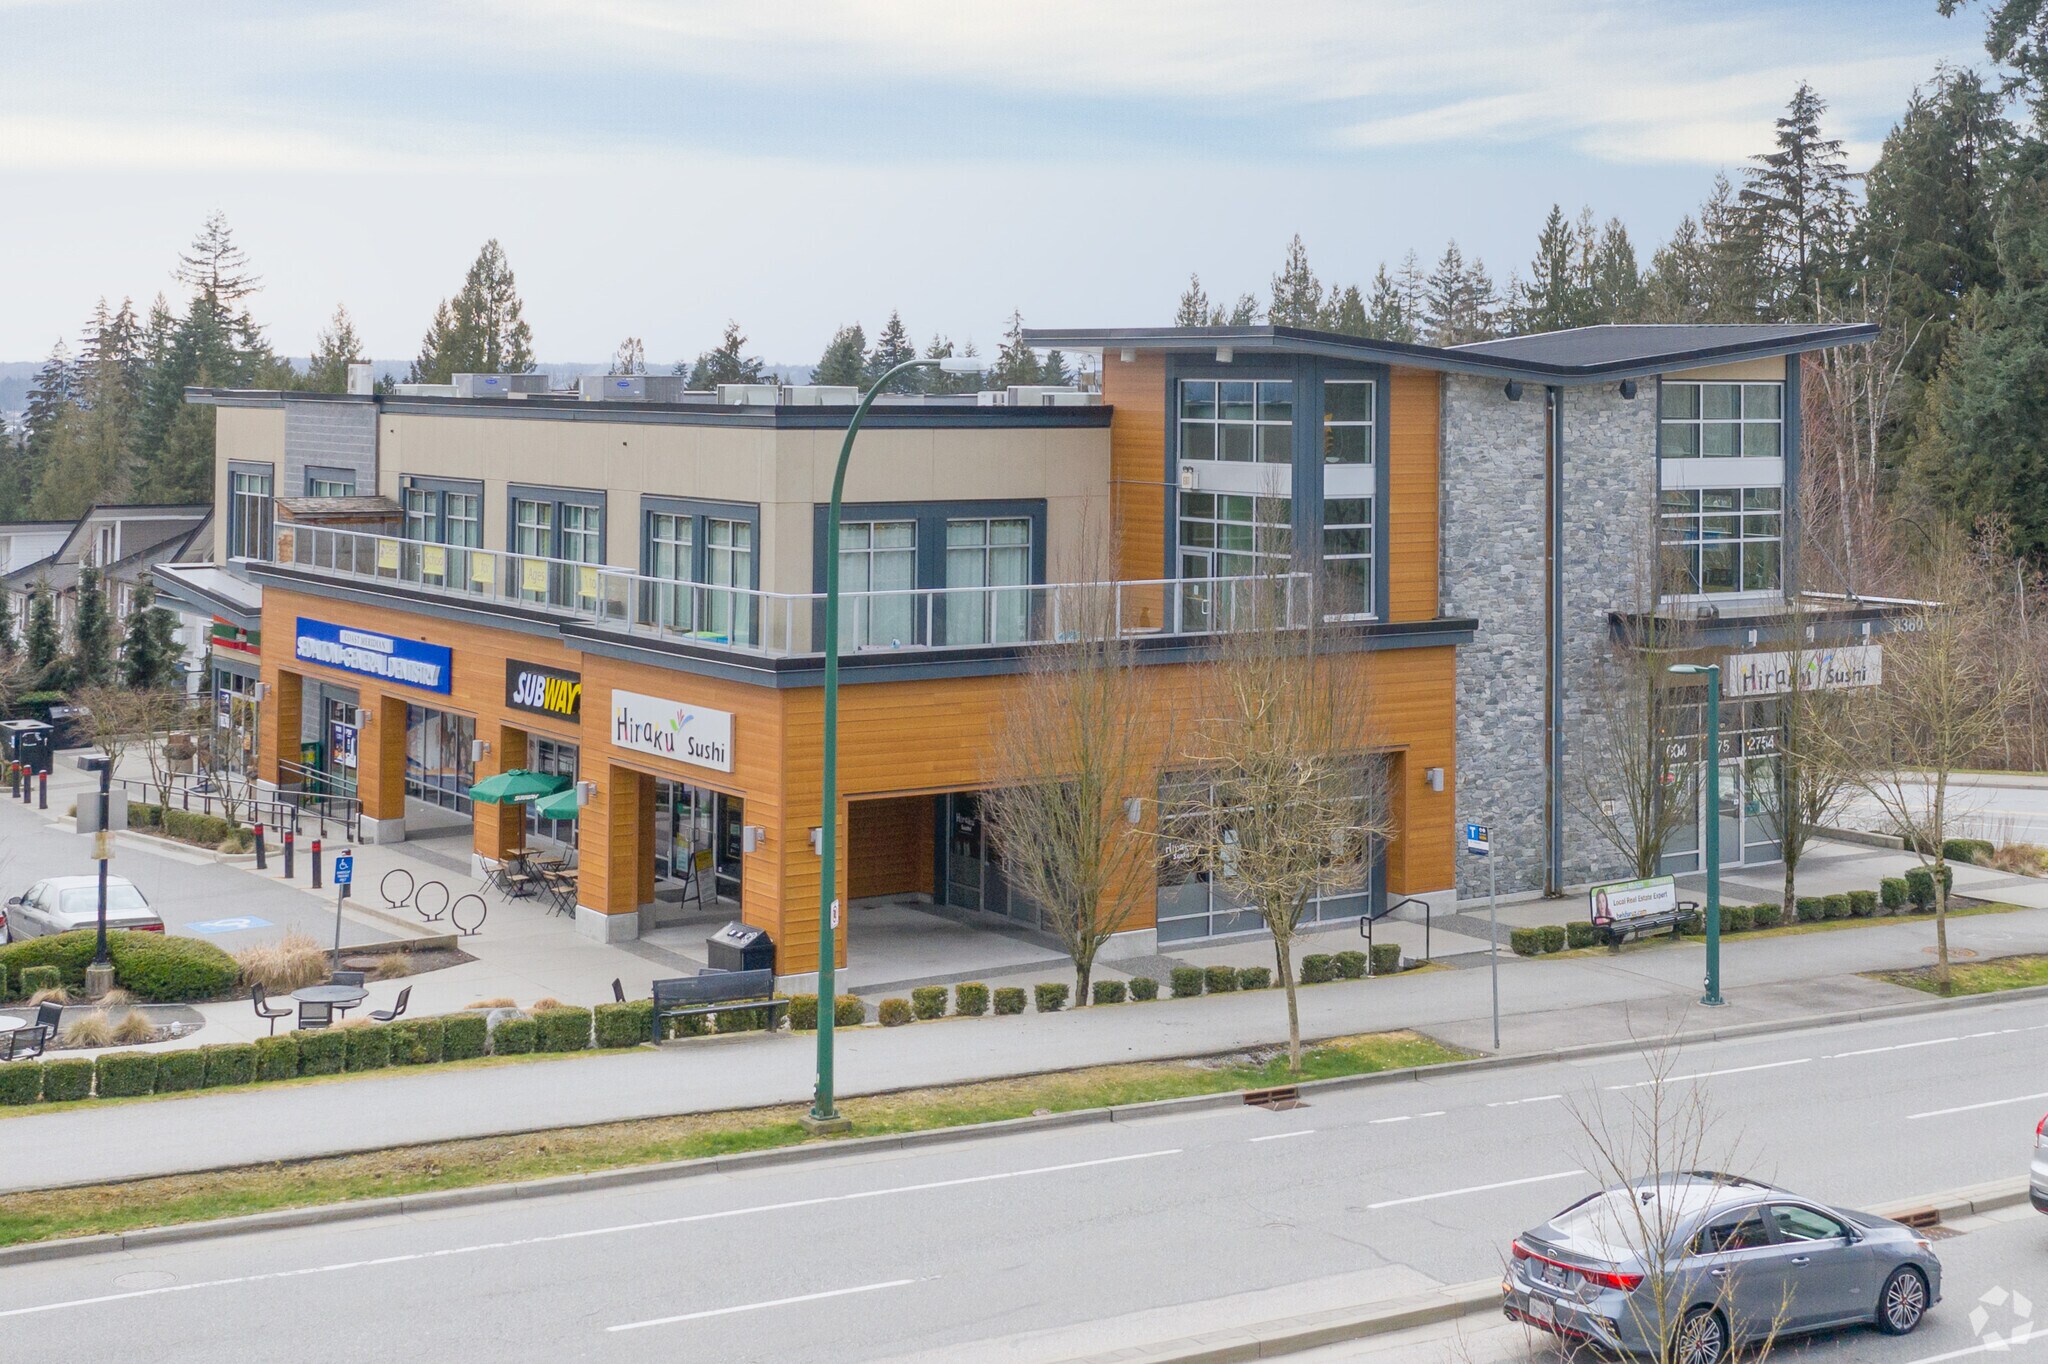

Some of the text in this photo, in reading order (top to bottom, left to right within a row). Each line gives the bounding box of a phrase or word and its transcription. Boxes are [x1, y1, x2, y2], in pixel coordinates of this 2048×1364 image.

[1826, 666, 1867, 685] Sushi
[513, 671, 582, 715] SUBWAY
[616, 707, 725, 762] Hiraku Sushi
[1613, 890, 1668, 906] Local Real Estate Expert
